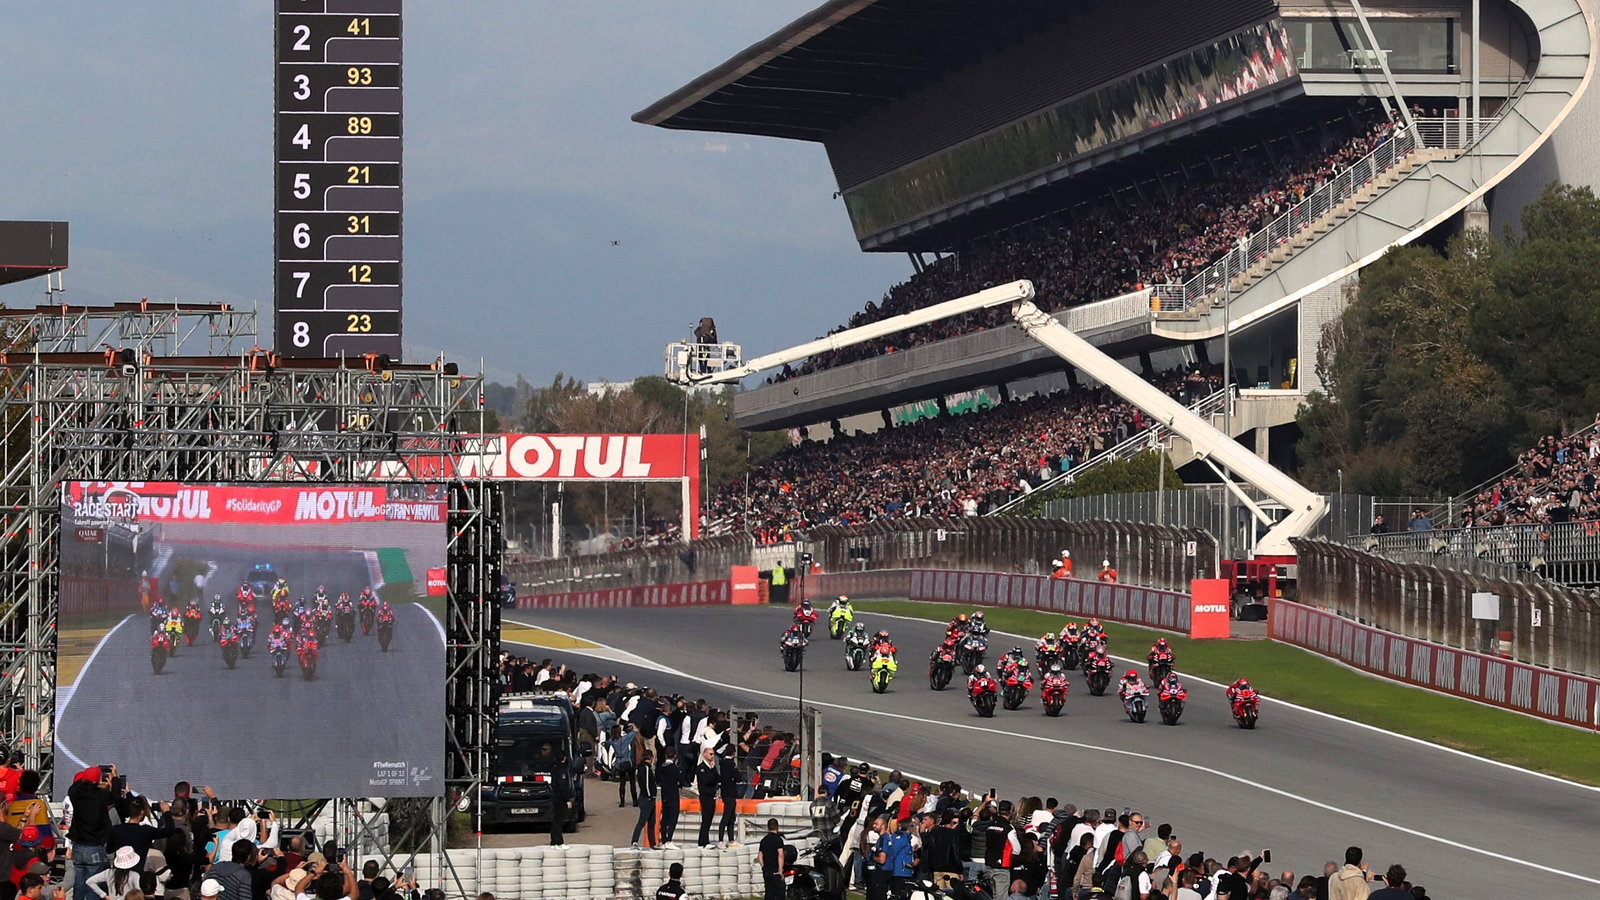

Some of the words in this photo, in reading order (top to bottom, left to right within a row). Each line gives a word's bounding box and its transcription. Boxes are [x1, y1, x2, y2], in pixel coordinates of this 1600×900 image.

[347, 18, 370, 36] 41
[293, 25, 311, 51] 2
[347, 67, 372, 85] 93
[293, 74, 311, 100] 3
[347, 116, 372, 134] 89
[292, 124, 311, 150] 4
[347, 166, 370, 184] 21
[293, 173, 311, 199] 5
[347, 216, 370, 233] 31
[292, 223, 311, 249] 6
[348, 265, 372, 282] 12
[293, 272, 311, 298] 7
[347, 314, 372, 332] 23
[292, 321, 310, 348] 8
[457, 435, 651, 478] MOTUL
[74, 502, 102, 517] RACE
[104, 502, 138, 518] START
[225, 498, 282, 514] #SolidarityGP
[294, 491, 376, 520] MOTUL
[78, 530, 97, 538] QATAR
[1194, 604, 1226, 613] MOTUL
[1485, 660, 1506, 703] MOTUL
[1511, 666, 1532, 710] MOTUL
[1537, 673, 1559, 716] MOTUL
[1565, 678, 1588, 723] MOTUL
